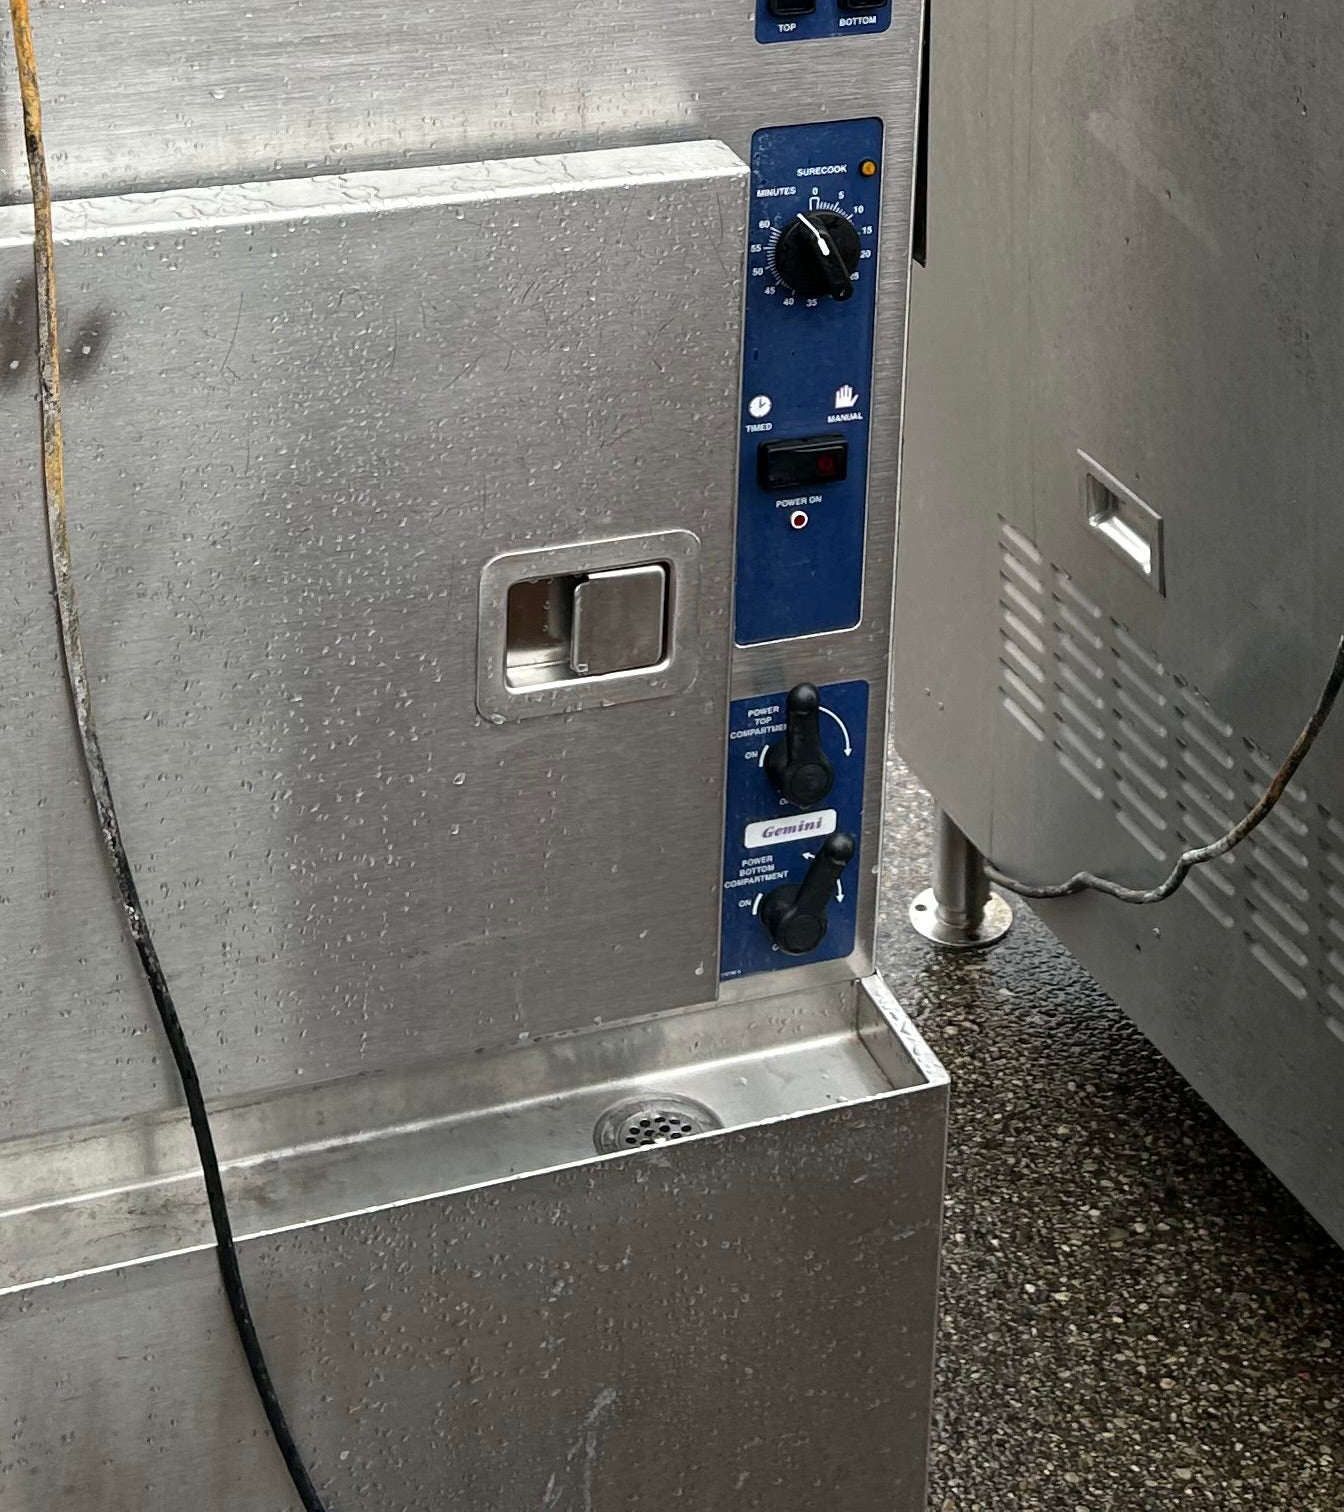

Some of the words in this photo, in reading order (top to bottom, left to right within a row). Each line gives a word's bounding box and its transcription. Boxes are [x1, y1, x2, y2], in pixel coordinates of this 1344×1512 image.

[839, 16, 877, 27] BOTTOM
[778, 24, 797, 32] TOP
[796, 164, 848, 177] SURECOOK
[756, 186, 796, 198] MINUTES
[854, 206, 864, 214] 10
[758, 220, 770, 228] 60
[862, 226, 872, 234] 15
[750, 244, 762, 252] 55
[860, 250, 872, 258] 20
[752, 268, 764, 276] 50
[764, 286, 776, 295] 45
[783, 298, 794, 306] 40
[806, 298, 818, 306] 35
[827, 412, 864, 423] MANUAL
[745, 422, 772, 432] TIMED
[776, 498, 808, 508] POWER
[808, 496, 822, 504] ON
[748, 706, 780, 717] POWER
[754, 716, 772, 726] TOP
[744, 750, 758, 760] ON
[762, 816, 823, 839] Gemini
[742, 855, 773, 868] POWER
[739, 864, 775, 876] BOTTOM
[724, 870, 790, 888] COMPARTMENT
[738, 900, 752, 908] ON
